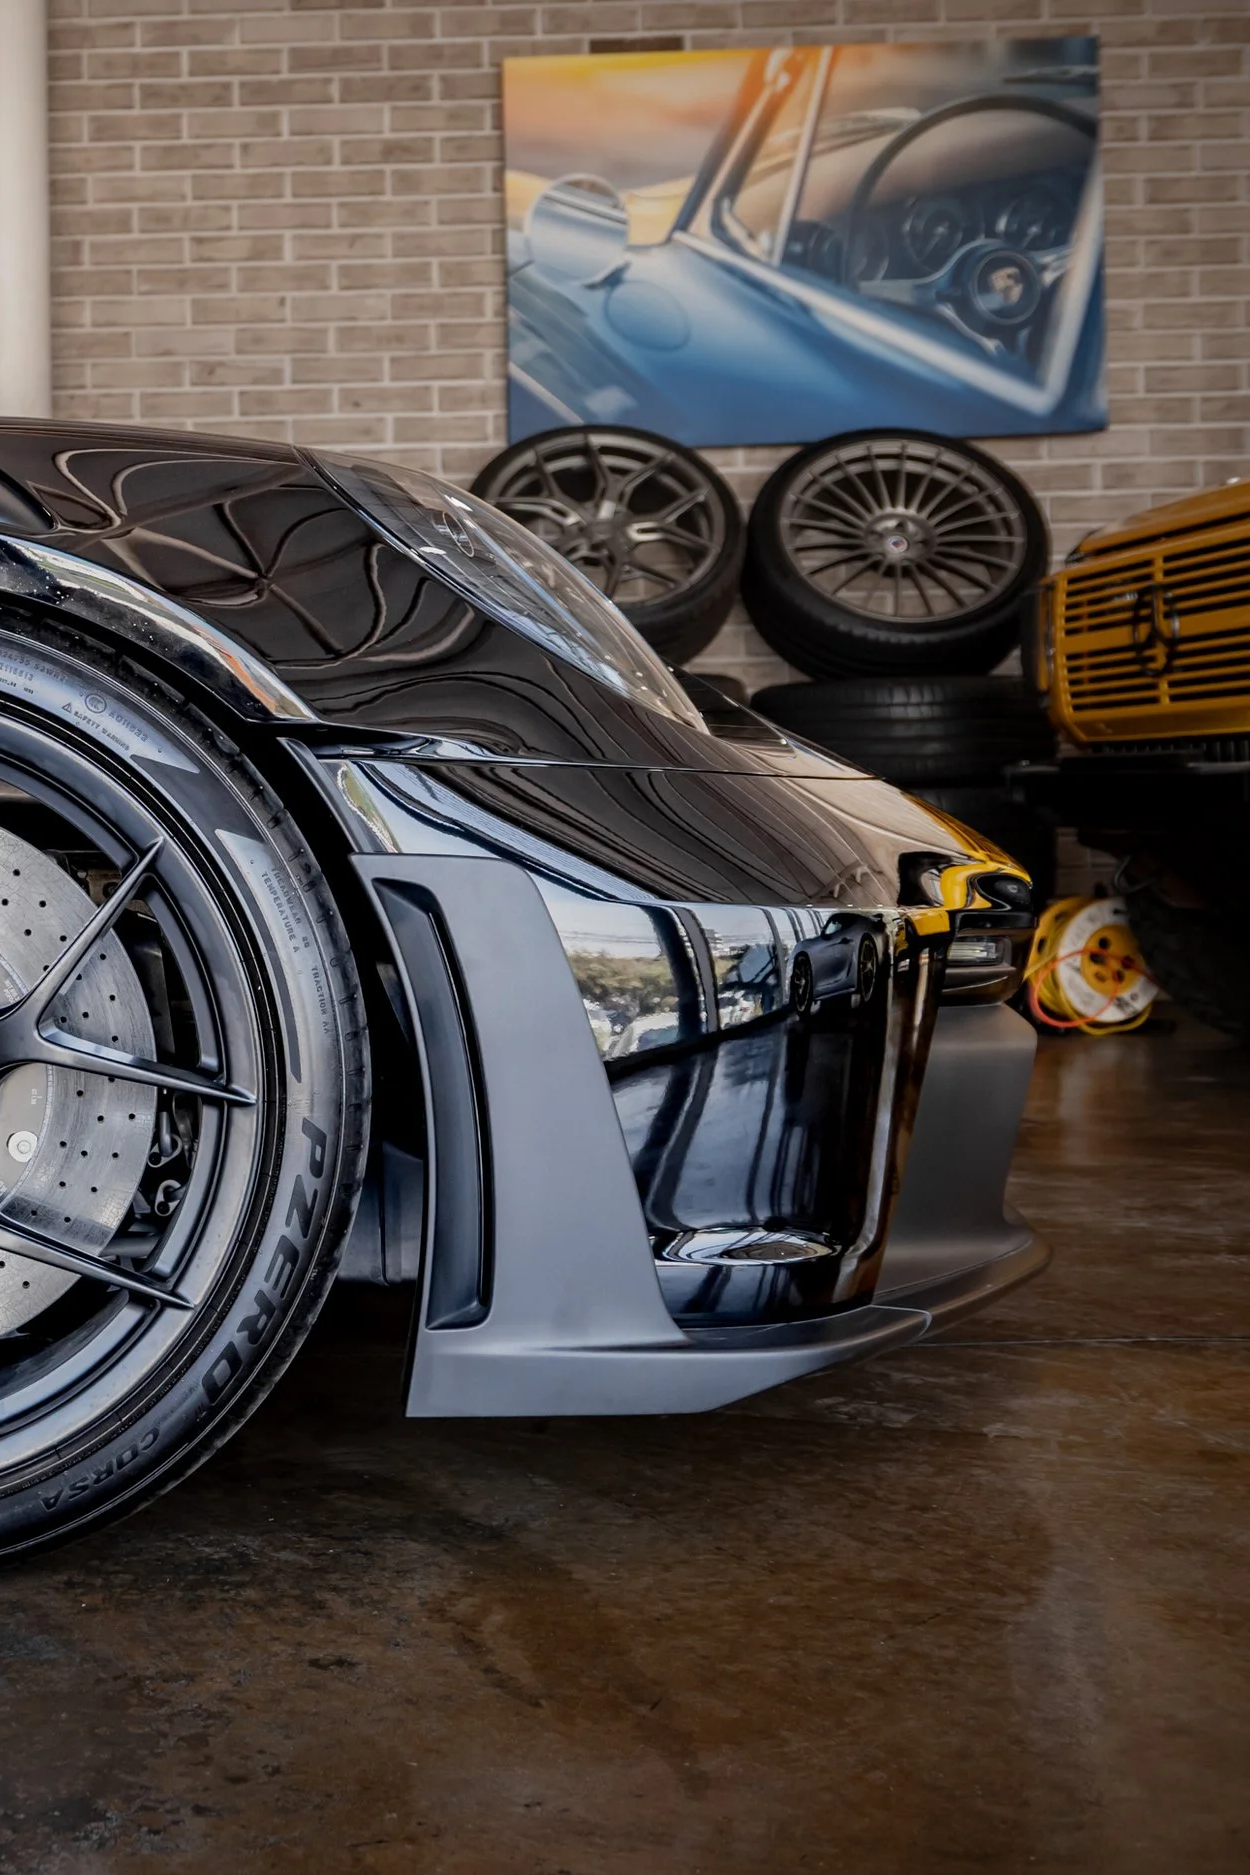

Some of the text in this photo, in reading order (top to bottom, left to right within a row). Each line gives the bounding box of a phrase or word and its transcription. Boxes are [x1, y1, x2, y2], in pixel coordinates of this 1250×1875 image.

[261, 870, 297, 941] TEMPERATURE
[270, 867, 302, 925] TREADWEAR
[309, 964, 328, 1015] TRACTION
[39, 1427, 160, 1512] CORSA
